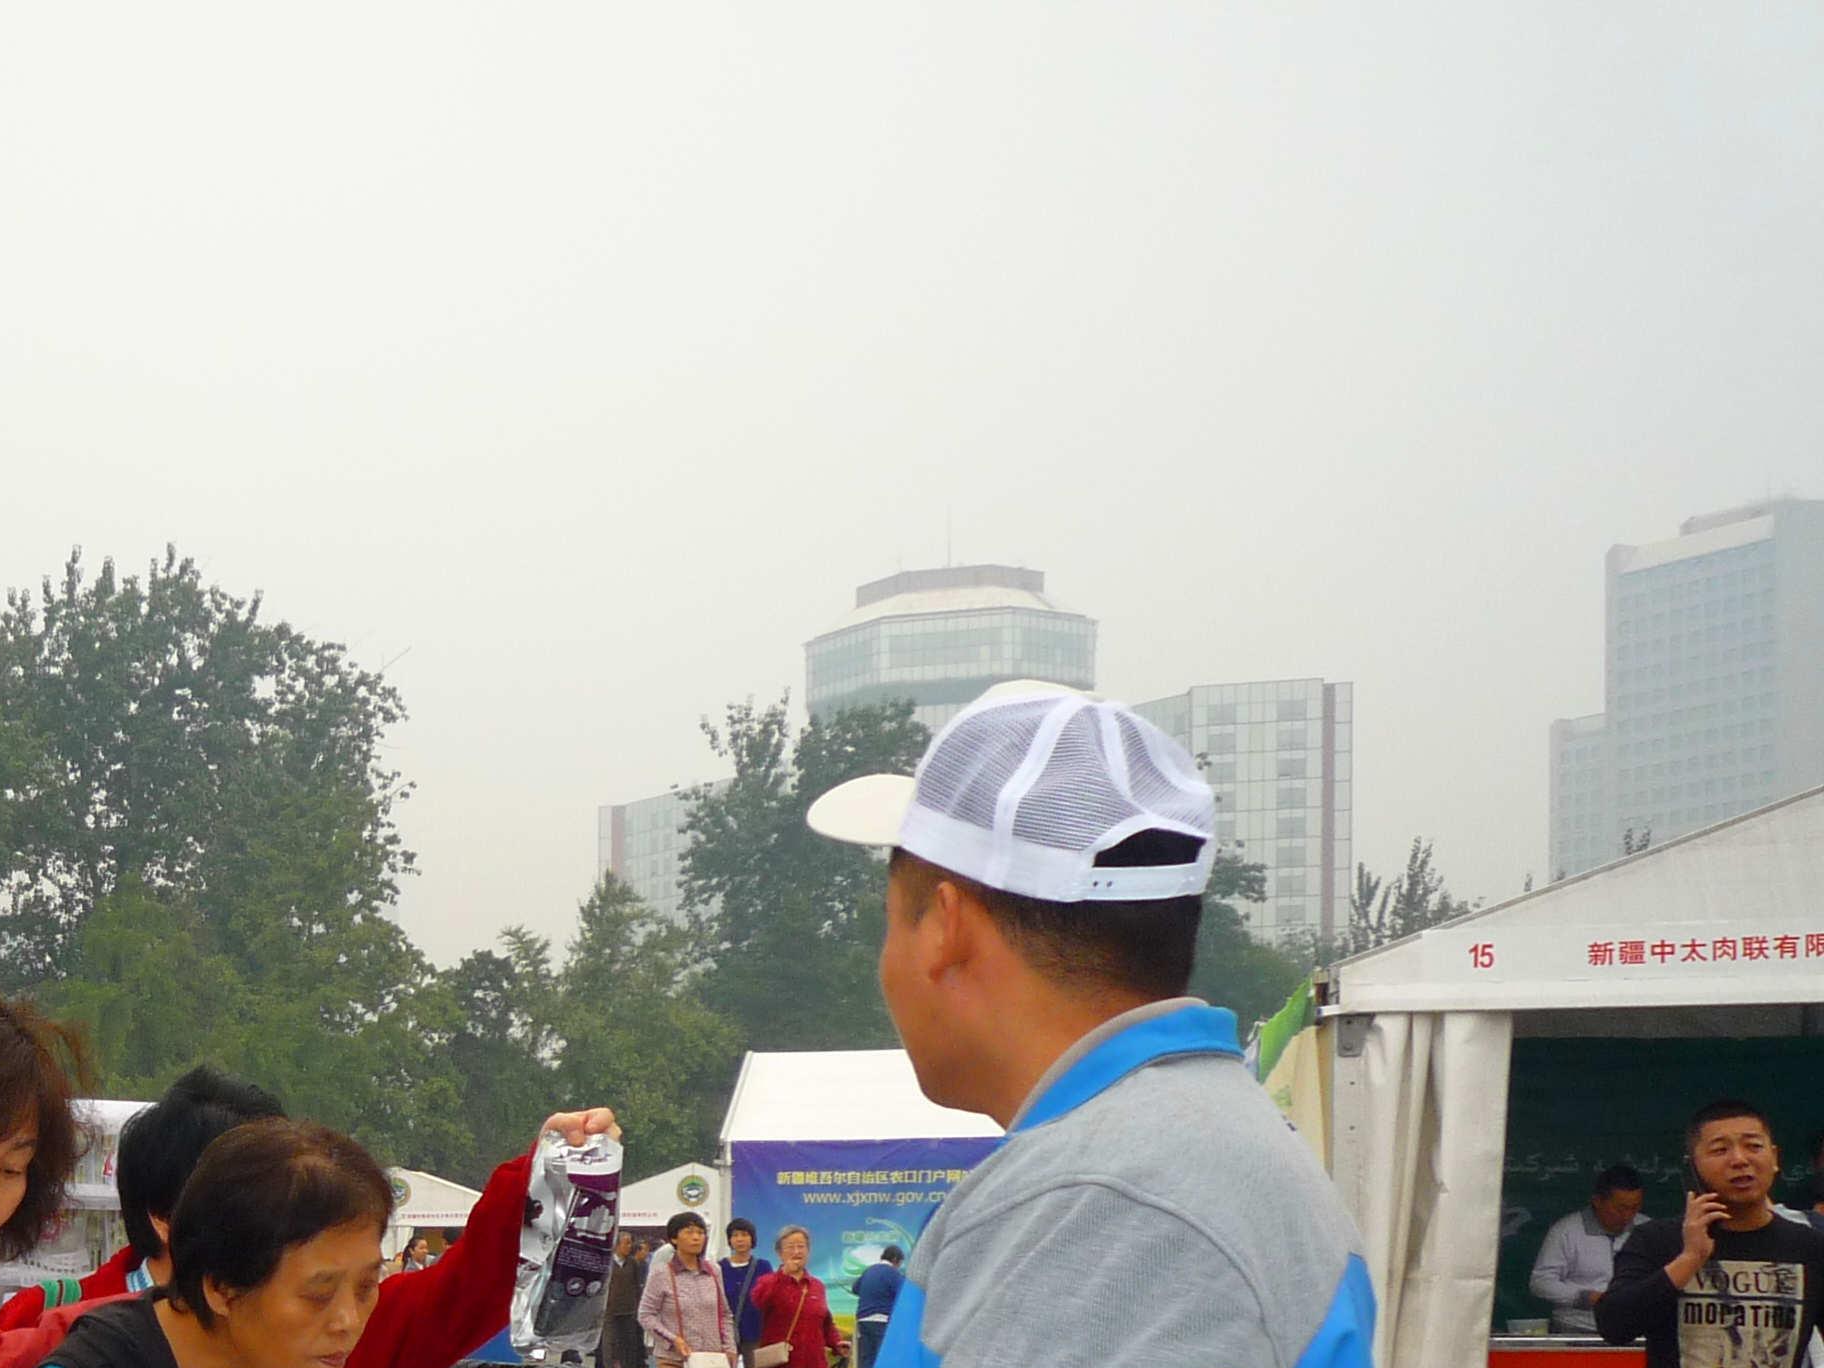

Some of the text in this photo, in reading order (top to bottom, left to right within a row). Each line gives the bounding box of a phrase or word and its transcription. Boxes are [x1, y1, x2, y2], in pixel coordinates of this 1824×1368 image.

[1469, 943, 1494, 968] 15
[1587, 933, 1824, 966] 新疆中太肉联有限
